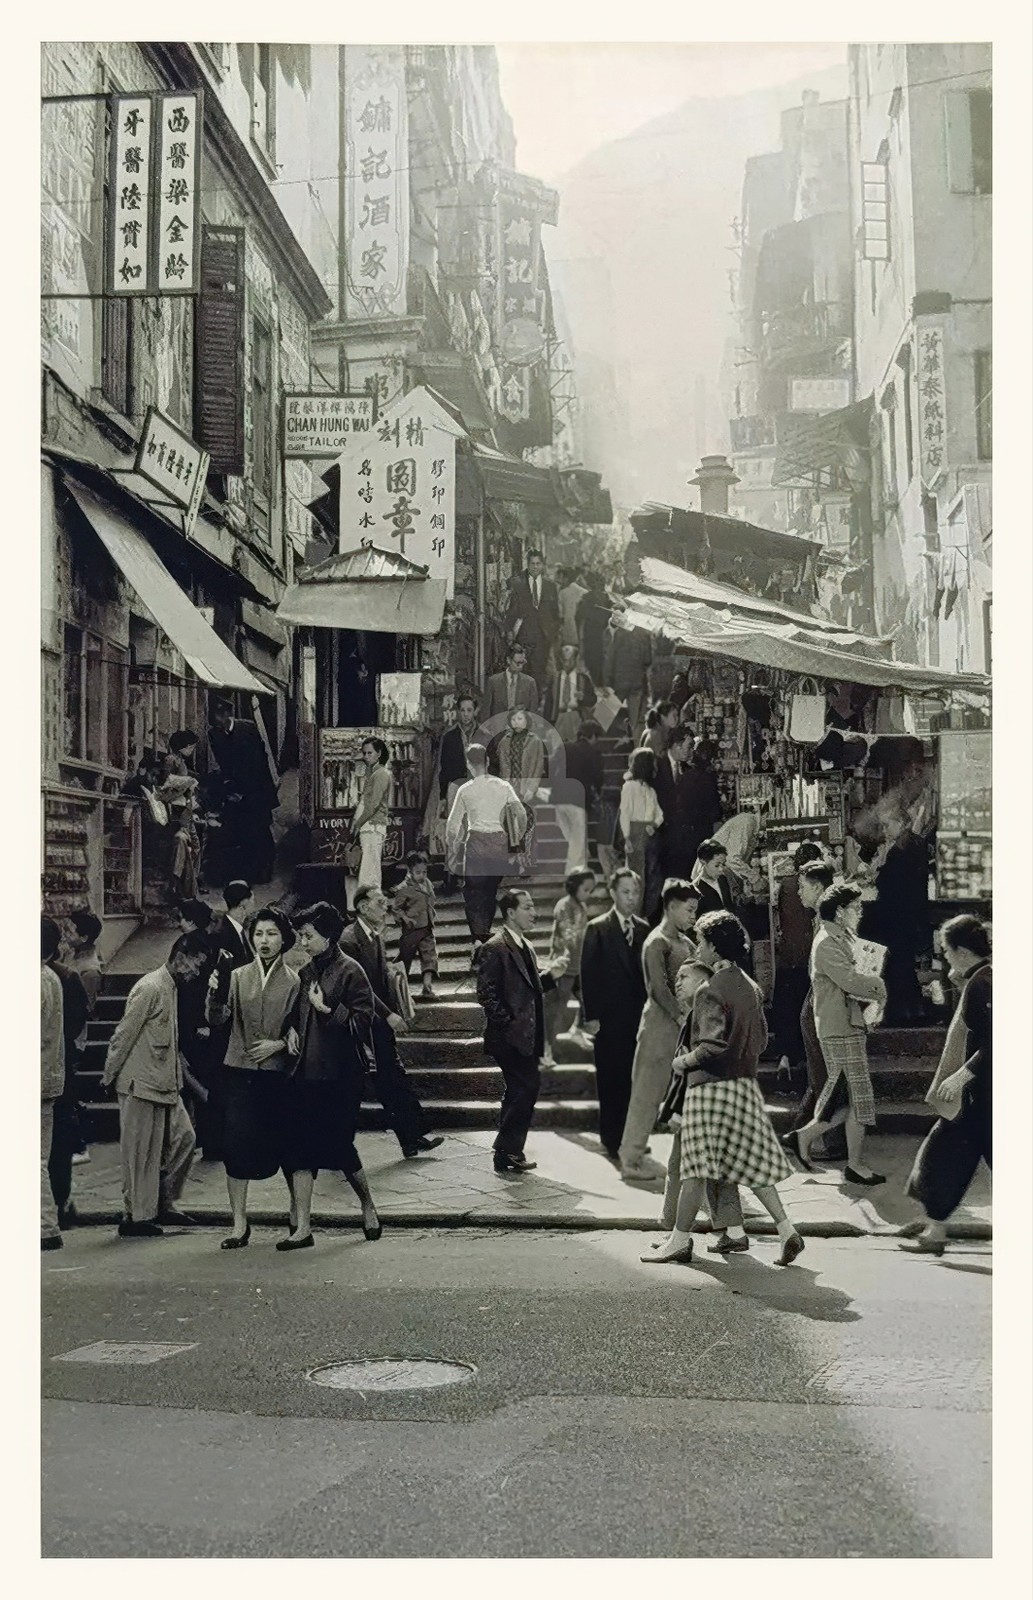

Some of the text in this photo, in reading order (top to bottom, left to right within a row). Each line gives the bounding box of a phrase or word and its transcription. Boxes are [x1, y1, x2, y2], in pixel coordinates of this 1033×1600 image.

[165, 106, 191, 281] 西醫梁金齡
[356, 95, 392, 280] 鏞記酒家
[287, 417, 317, 433] CHAN
[320, 417, 350, 433] HUNG
[309, 437, 347, 447] TAILOR
[319, 818, 351, 829] IVORY
